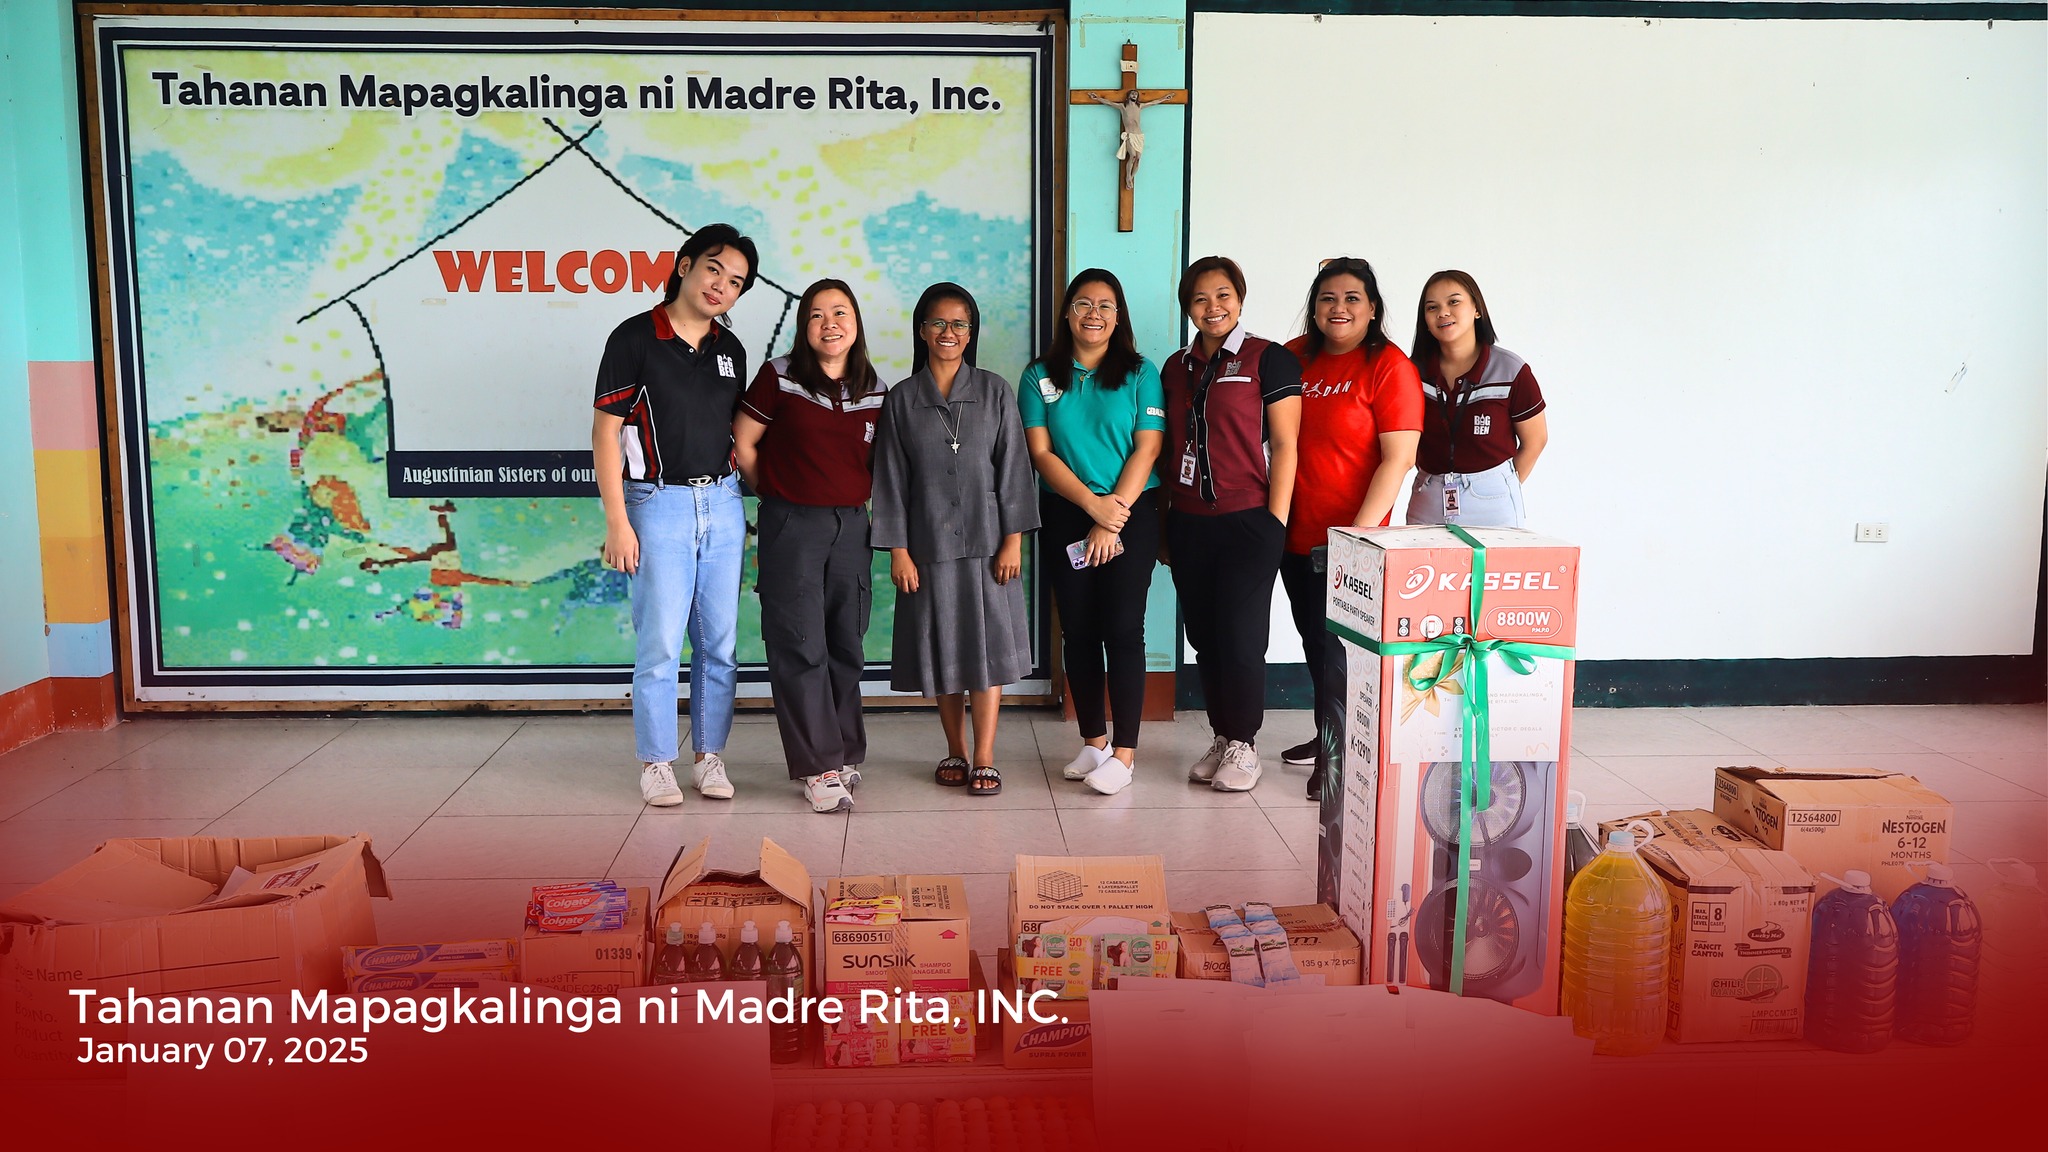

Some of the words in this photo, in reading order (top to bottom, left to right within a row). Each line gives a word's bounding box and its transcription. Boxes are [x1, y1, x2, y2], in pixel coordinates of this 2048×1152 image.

[152, 71, 327, 107] Tahanan
[340, 74, 627, 117] Mapagkalinga
[639, 75, 674, 110] ni
[687, 76, 816, 110] Madre
[829, 75, 919, 115] Rita,
[932, 77, 1002, 110] Inc.
[432, 249, 677, 294] WELCOM
[402, 466, 494, 485] Augustinian
[498, 467, 547, 482] Sisters
[551, 466, 567, 482] of
[1343, 573, 1373, 600] KASSEL
[1333, 596, 1350, 613] PORTABLE
[1497, 611, 1551, 626] 8800W
[1791, 813, 1837, 823] 12564800
[1881, 819, 1946, 834] NESTOGEN
[1897, 836, 1927, 849] 6-12
[1890, 851, 1932, 859] MONTHS
[546, 898, 590, 909] Colgate
[1714, 907, 1723, 921] 8
[541, 916, 585, 926] Colgate
[834, 932, 891, 942] 68690510
[1069, 937, 1082, 947] 50
[1155, 940, 1168, 951] 50
[365, 949, 418, 966] CHAMPION
[595, 948, 632, 960] 01339
[1691, 950, 1724, 958] CANTON
[1301, 959, 1316, 968] 135
[1342, 957, 1358, 968] pcs.
[36, 968, 83, 982] Name
[1033, 965, 1063, 976] FREE
[362, 976, 415, 992] CHAMPION
[912, 1024, 947, 1037] FREE
[1020, 1024, 1092, 1048] CHAMPION
[876, 1038, 889, 1049] 50
